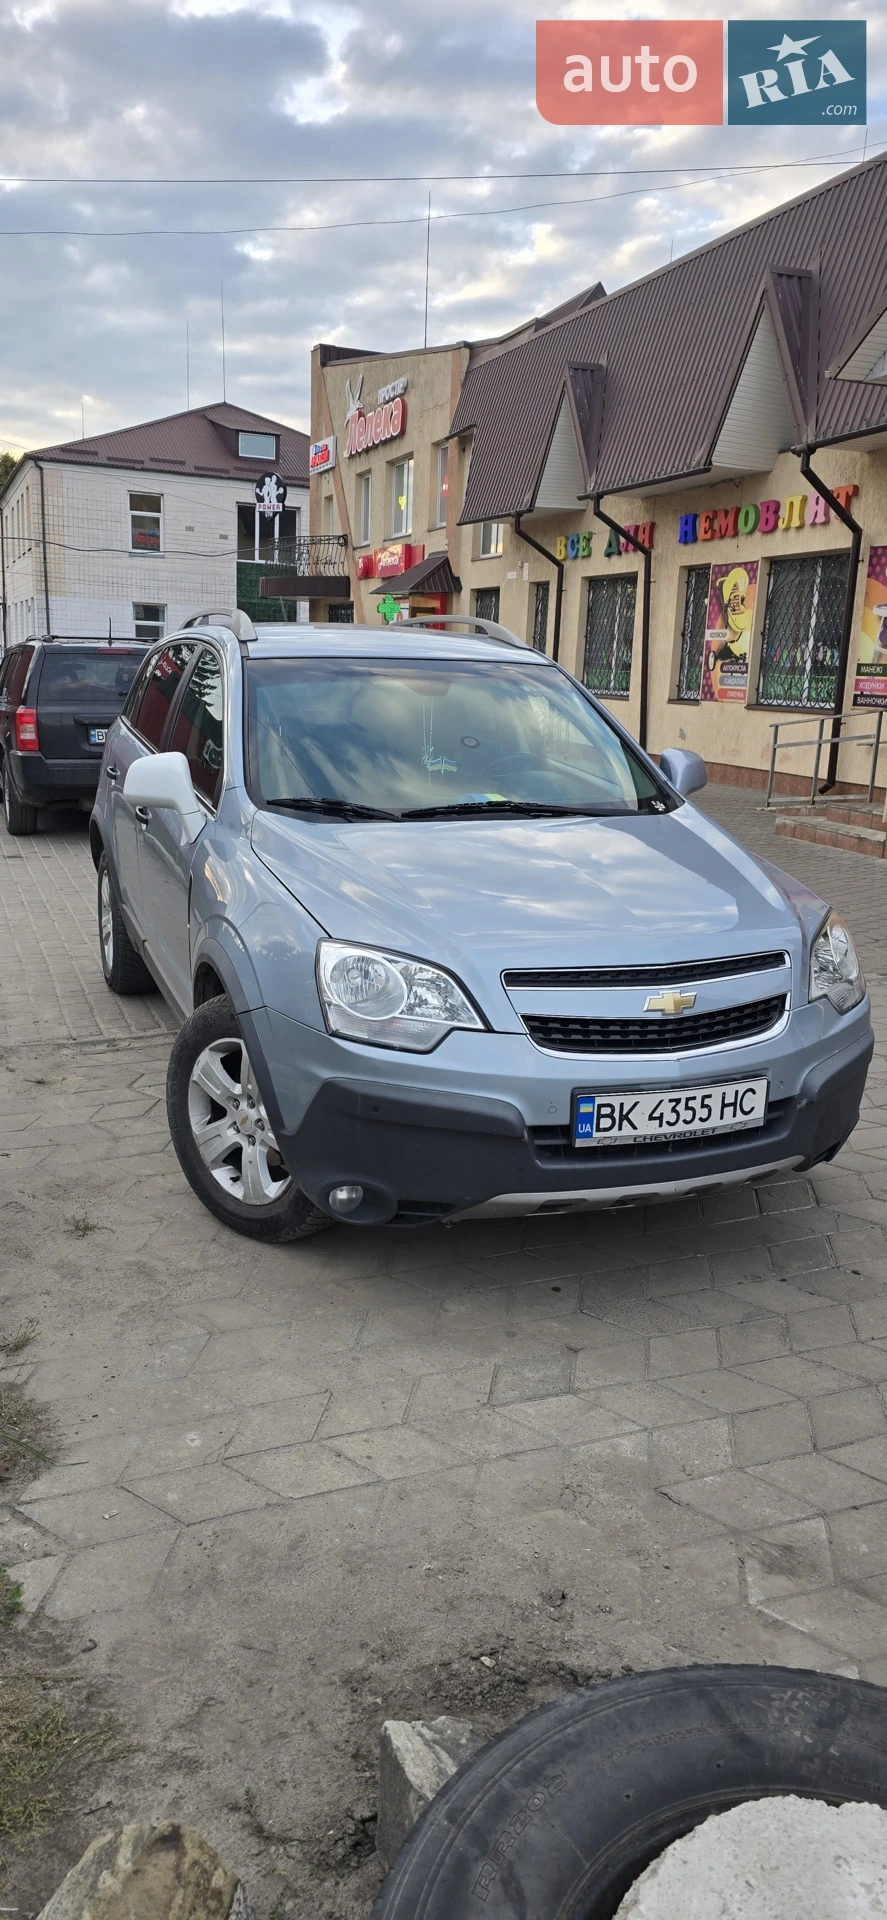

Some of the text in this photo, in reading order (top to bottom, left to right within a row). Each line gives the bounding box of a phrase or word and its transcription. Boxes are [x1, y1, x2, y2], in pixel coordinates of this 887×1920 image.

[345, 398, 404, 457] Лелека
[556, 531, 593, 561] ВСЕ
[678, 484, 859, 544] НЕМОВЛЯТ
[709, 631, 728, 639] КОЛЯСКИ
[858, 681, 885, 690] ХОДУНКИ
[856, 696, 887, 706] ВАННОЧКИ
[595, 1087, 757, 1133] BK 4355 HC
[578, 1123, 592, 1133] UA
[633, 1128, 717, 1143] CHEVROLET
[471, 1772, 569, 1902] RR202
